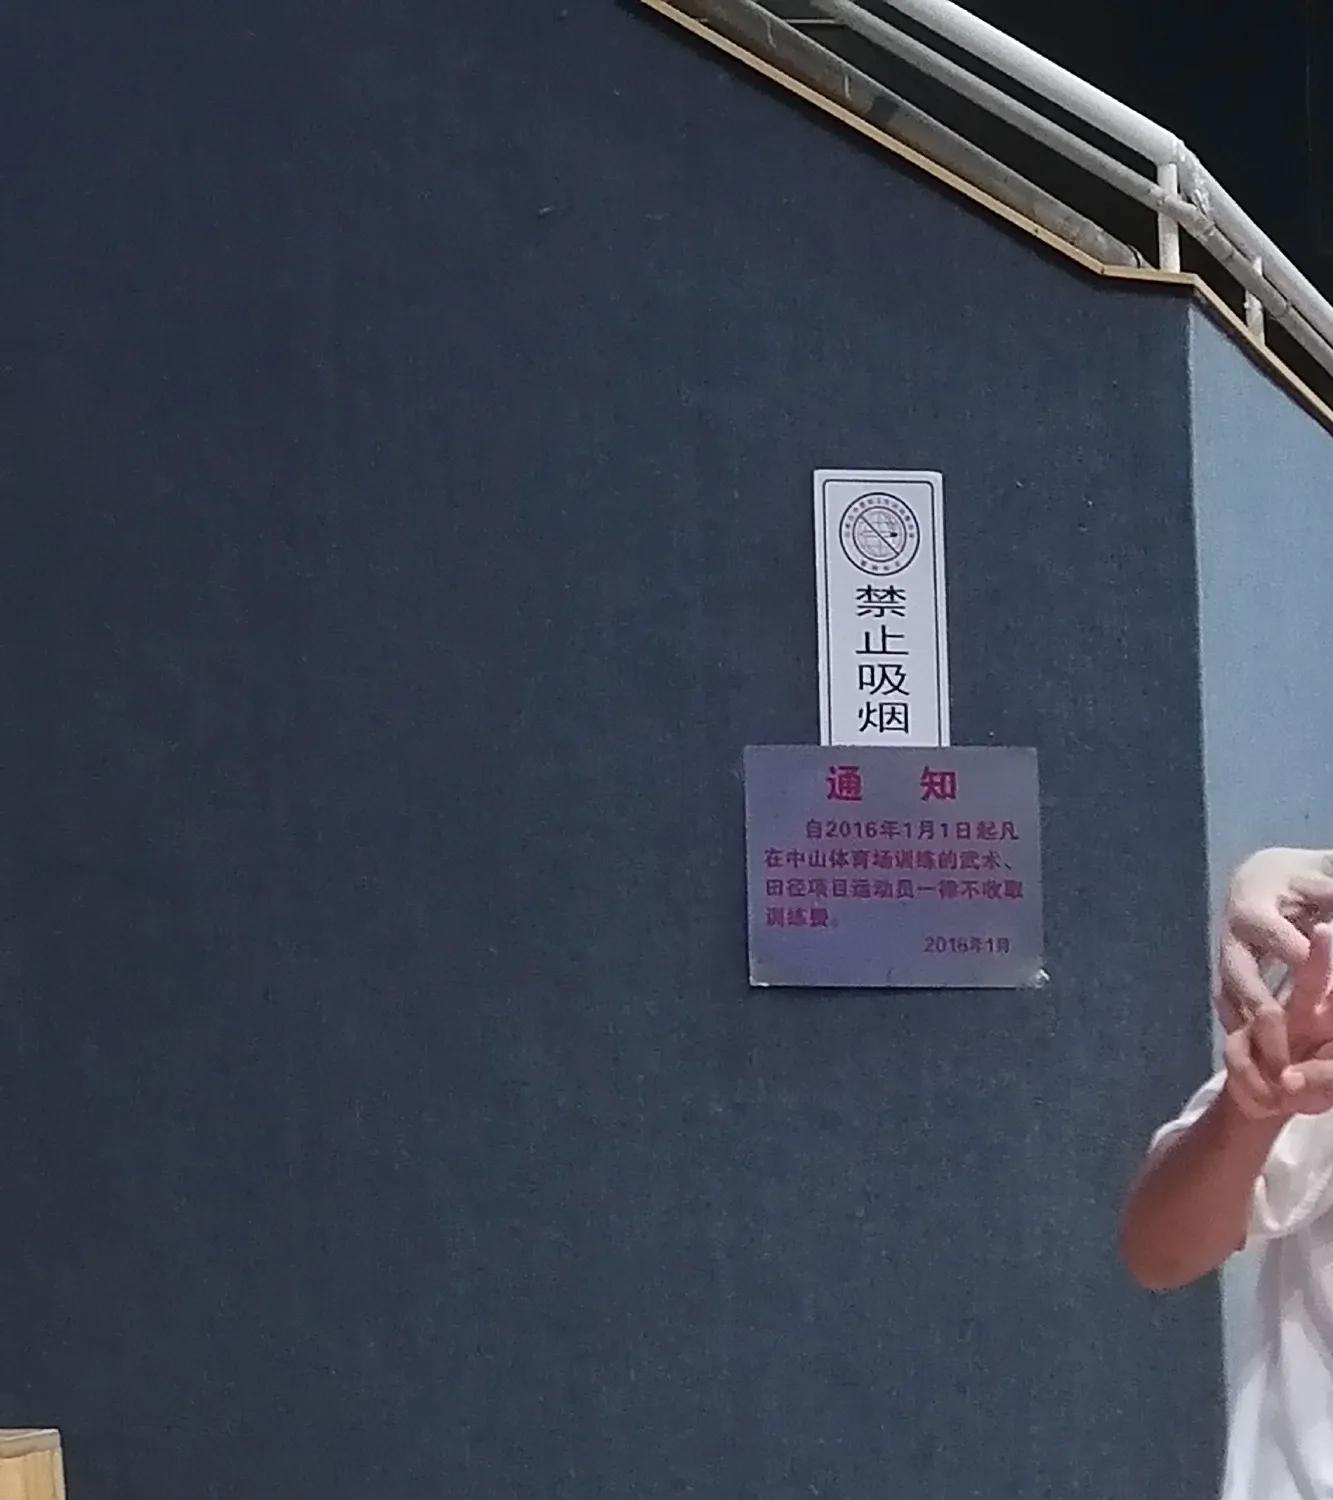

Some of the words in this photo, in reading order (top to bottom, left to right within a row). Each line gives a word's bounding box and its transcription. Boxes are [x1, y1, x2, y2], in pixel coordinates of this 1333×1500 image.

[855, 584, 910, 734] 禁止吸烟
[826, 765, 957, 801] 通知
[805, 818, 1019, 841] 自2016年1月1日起凡
